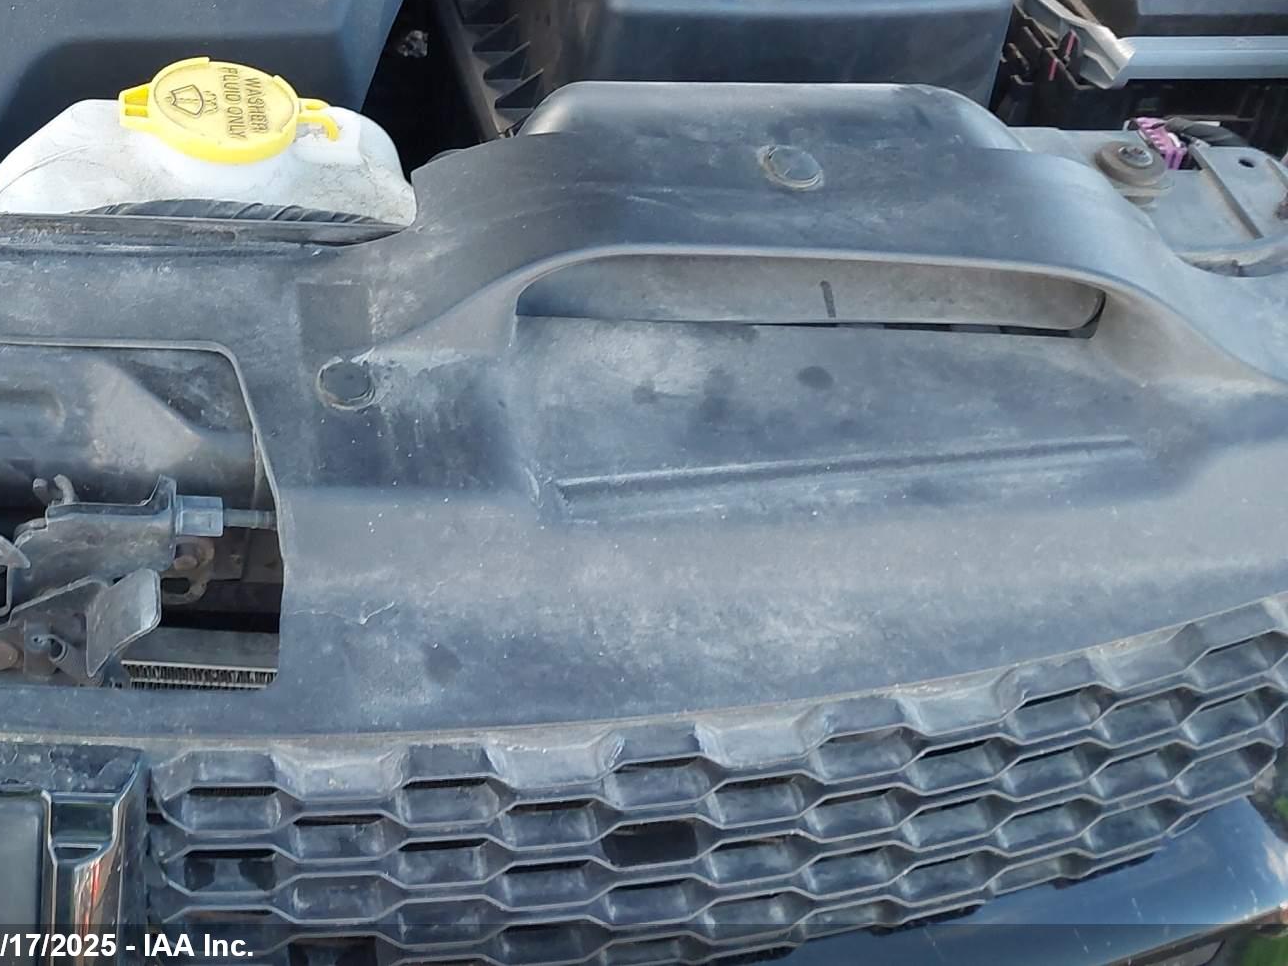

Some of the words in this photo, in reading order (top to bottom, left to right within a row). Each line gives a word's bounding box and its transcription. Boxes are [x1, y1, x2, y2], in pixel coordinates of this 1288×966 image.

[220, 66, 242, 103] FLUID
[226, 106, 248, 140] ONLY
[244, 77, 269, 133] WASHER
